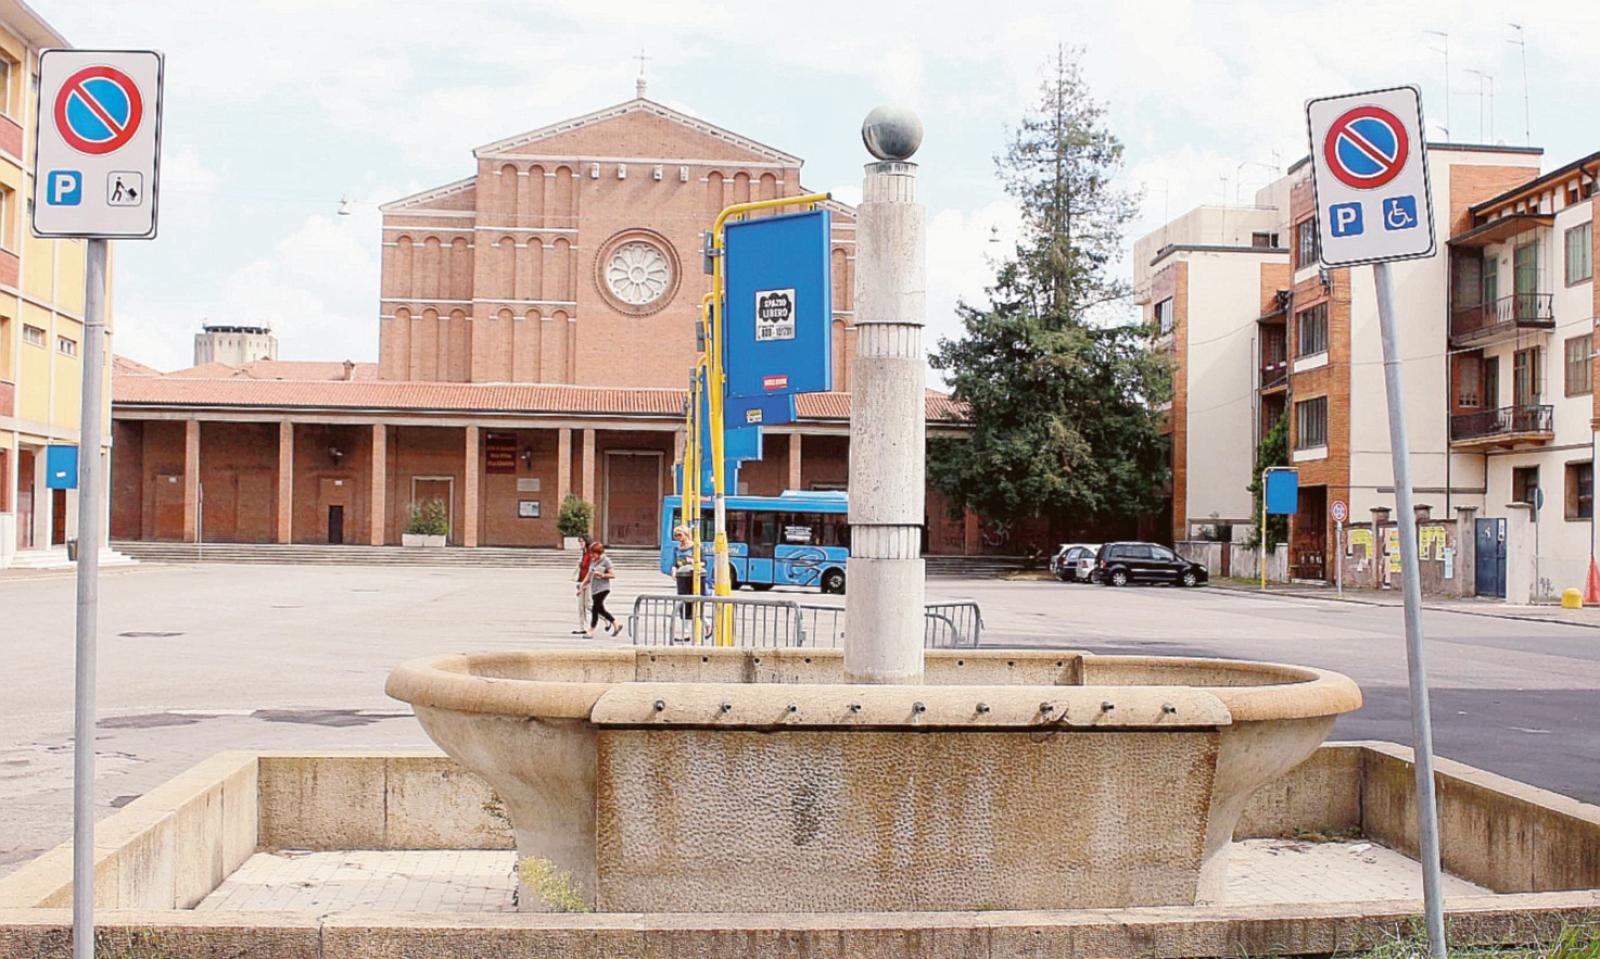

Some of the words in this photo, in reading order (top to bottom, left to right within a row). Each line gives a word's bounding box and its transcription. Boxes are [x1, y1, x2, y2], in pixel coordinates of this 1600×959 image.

[55, 174, 77, 202] P
[1337, 207, 1357, 233] P
[764, 298, 787, 308] SPAZIO
[763, 308, 788, 318] LIBERO
